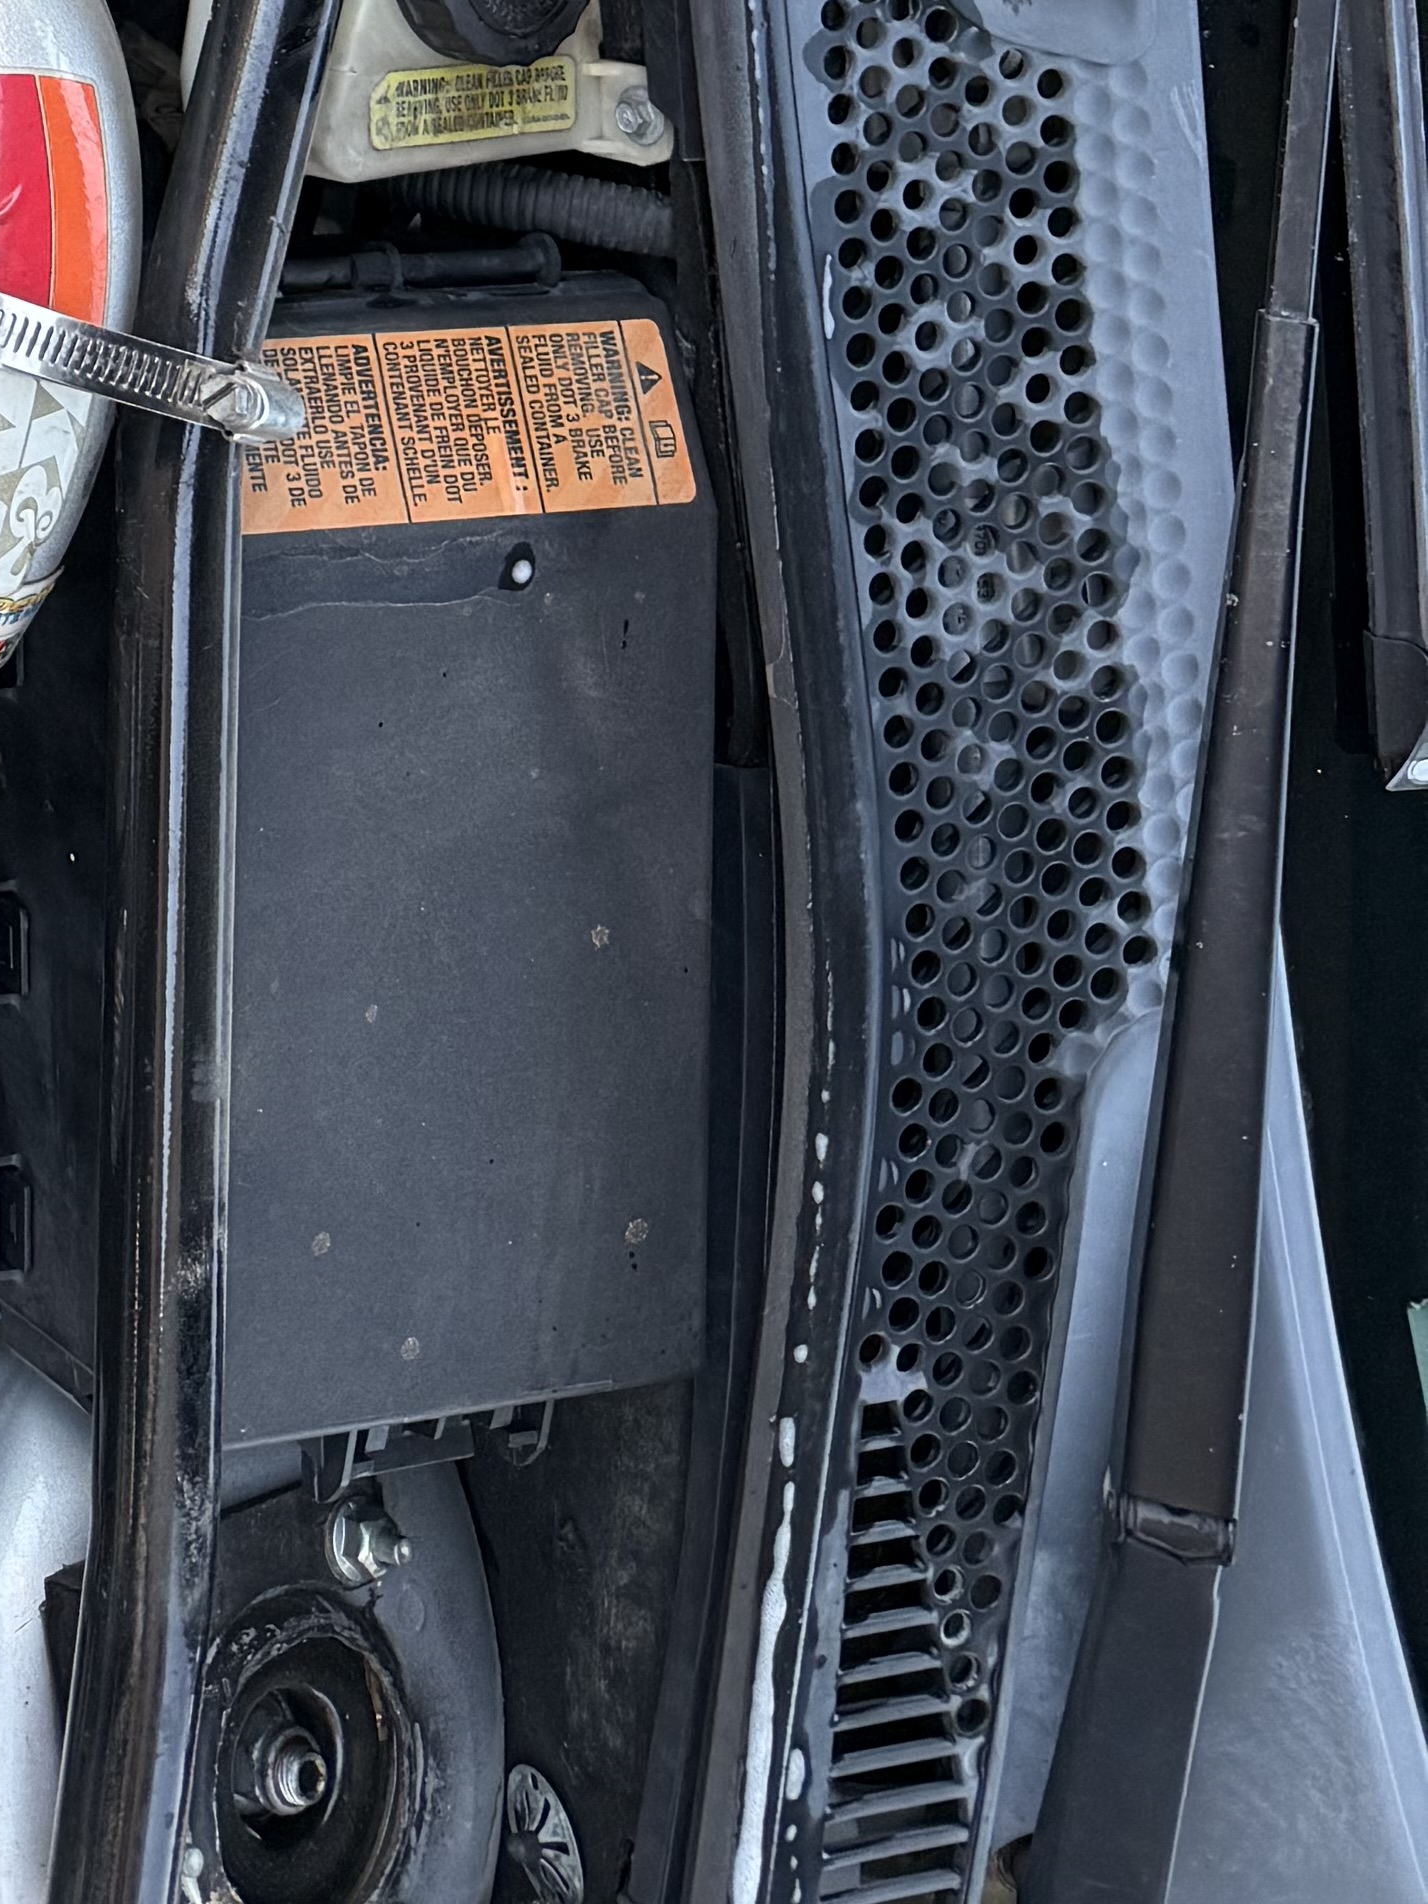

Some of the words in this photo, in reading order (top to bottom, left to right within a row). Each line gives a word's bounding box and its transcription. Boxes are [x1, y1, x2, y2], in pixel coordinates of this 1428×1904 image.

[334, 345, 356, 396] LIMPIE
[416, 339, 443, 399] LIQUIDE
[451, 338, 476, 410] BOUCHON
[467, 336, 497, 414] NETTOYER
[532, 334, 555, 380] FLUID
[548, 333, 569, 372] ONLY
[582, 332, 606, 383] FILLER
[298, 346, 329, 434] EXTRAERLO
[315, 440, 335, 469] USE
[316, 346, 344, 424] LLENANDO
[344, 400, 360, 418] EL
[352, 344, 388, 471] ADVERTENCIA:
[434, 338, 465, 433] N'EMPLOYER
[484, 335, 527, 479] AVERTISSEMENT
[539, 383, 561, 431] FROM
[557, 376, 578, 407] DOT
[566, 332, 594, 419] REMOVING.
[586, 427, 604, 458] USE
[591, 388, 614, 419] CAP
[599, 331, 632, 422] WARNING:
[620, 426, 644, 479] CLEAN
[383, 341, 413, 434] CONTENANT
[400, 437, 428, 507] SCHELLE.
[401, 354, 432, 445] PROVENANT
[419, 448, 440, 485] D'UN
[429, 401, 449, 422] DE
[515, 335, 539, 395] SEALED
[527, 398, 560, 493] CONTAINER.
[300, 445, 323, 499] FLUIDO
[331, 429, 354, 479] ANTES
[348, 423, 372, 473] TAPON
[431, 425, 457, 472] FREIN
[450, 437, 472, 470] QUE
[568, 427, 593, 480] BRAKE
[602, 425, 627, 485] BEFORE
[288, 487, 306, 508] DE
[342, 485, 360, 505] DE
[359, 477, 376, 497] DE
[442, 474, 463, 504] DOT
[459, 472, 479, 493] DU
